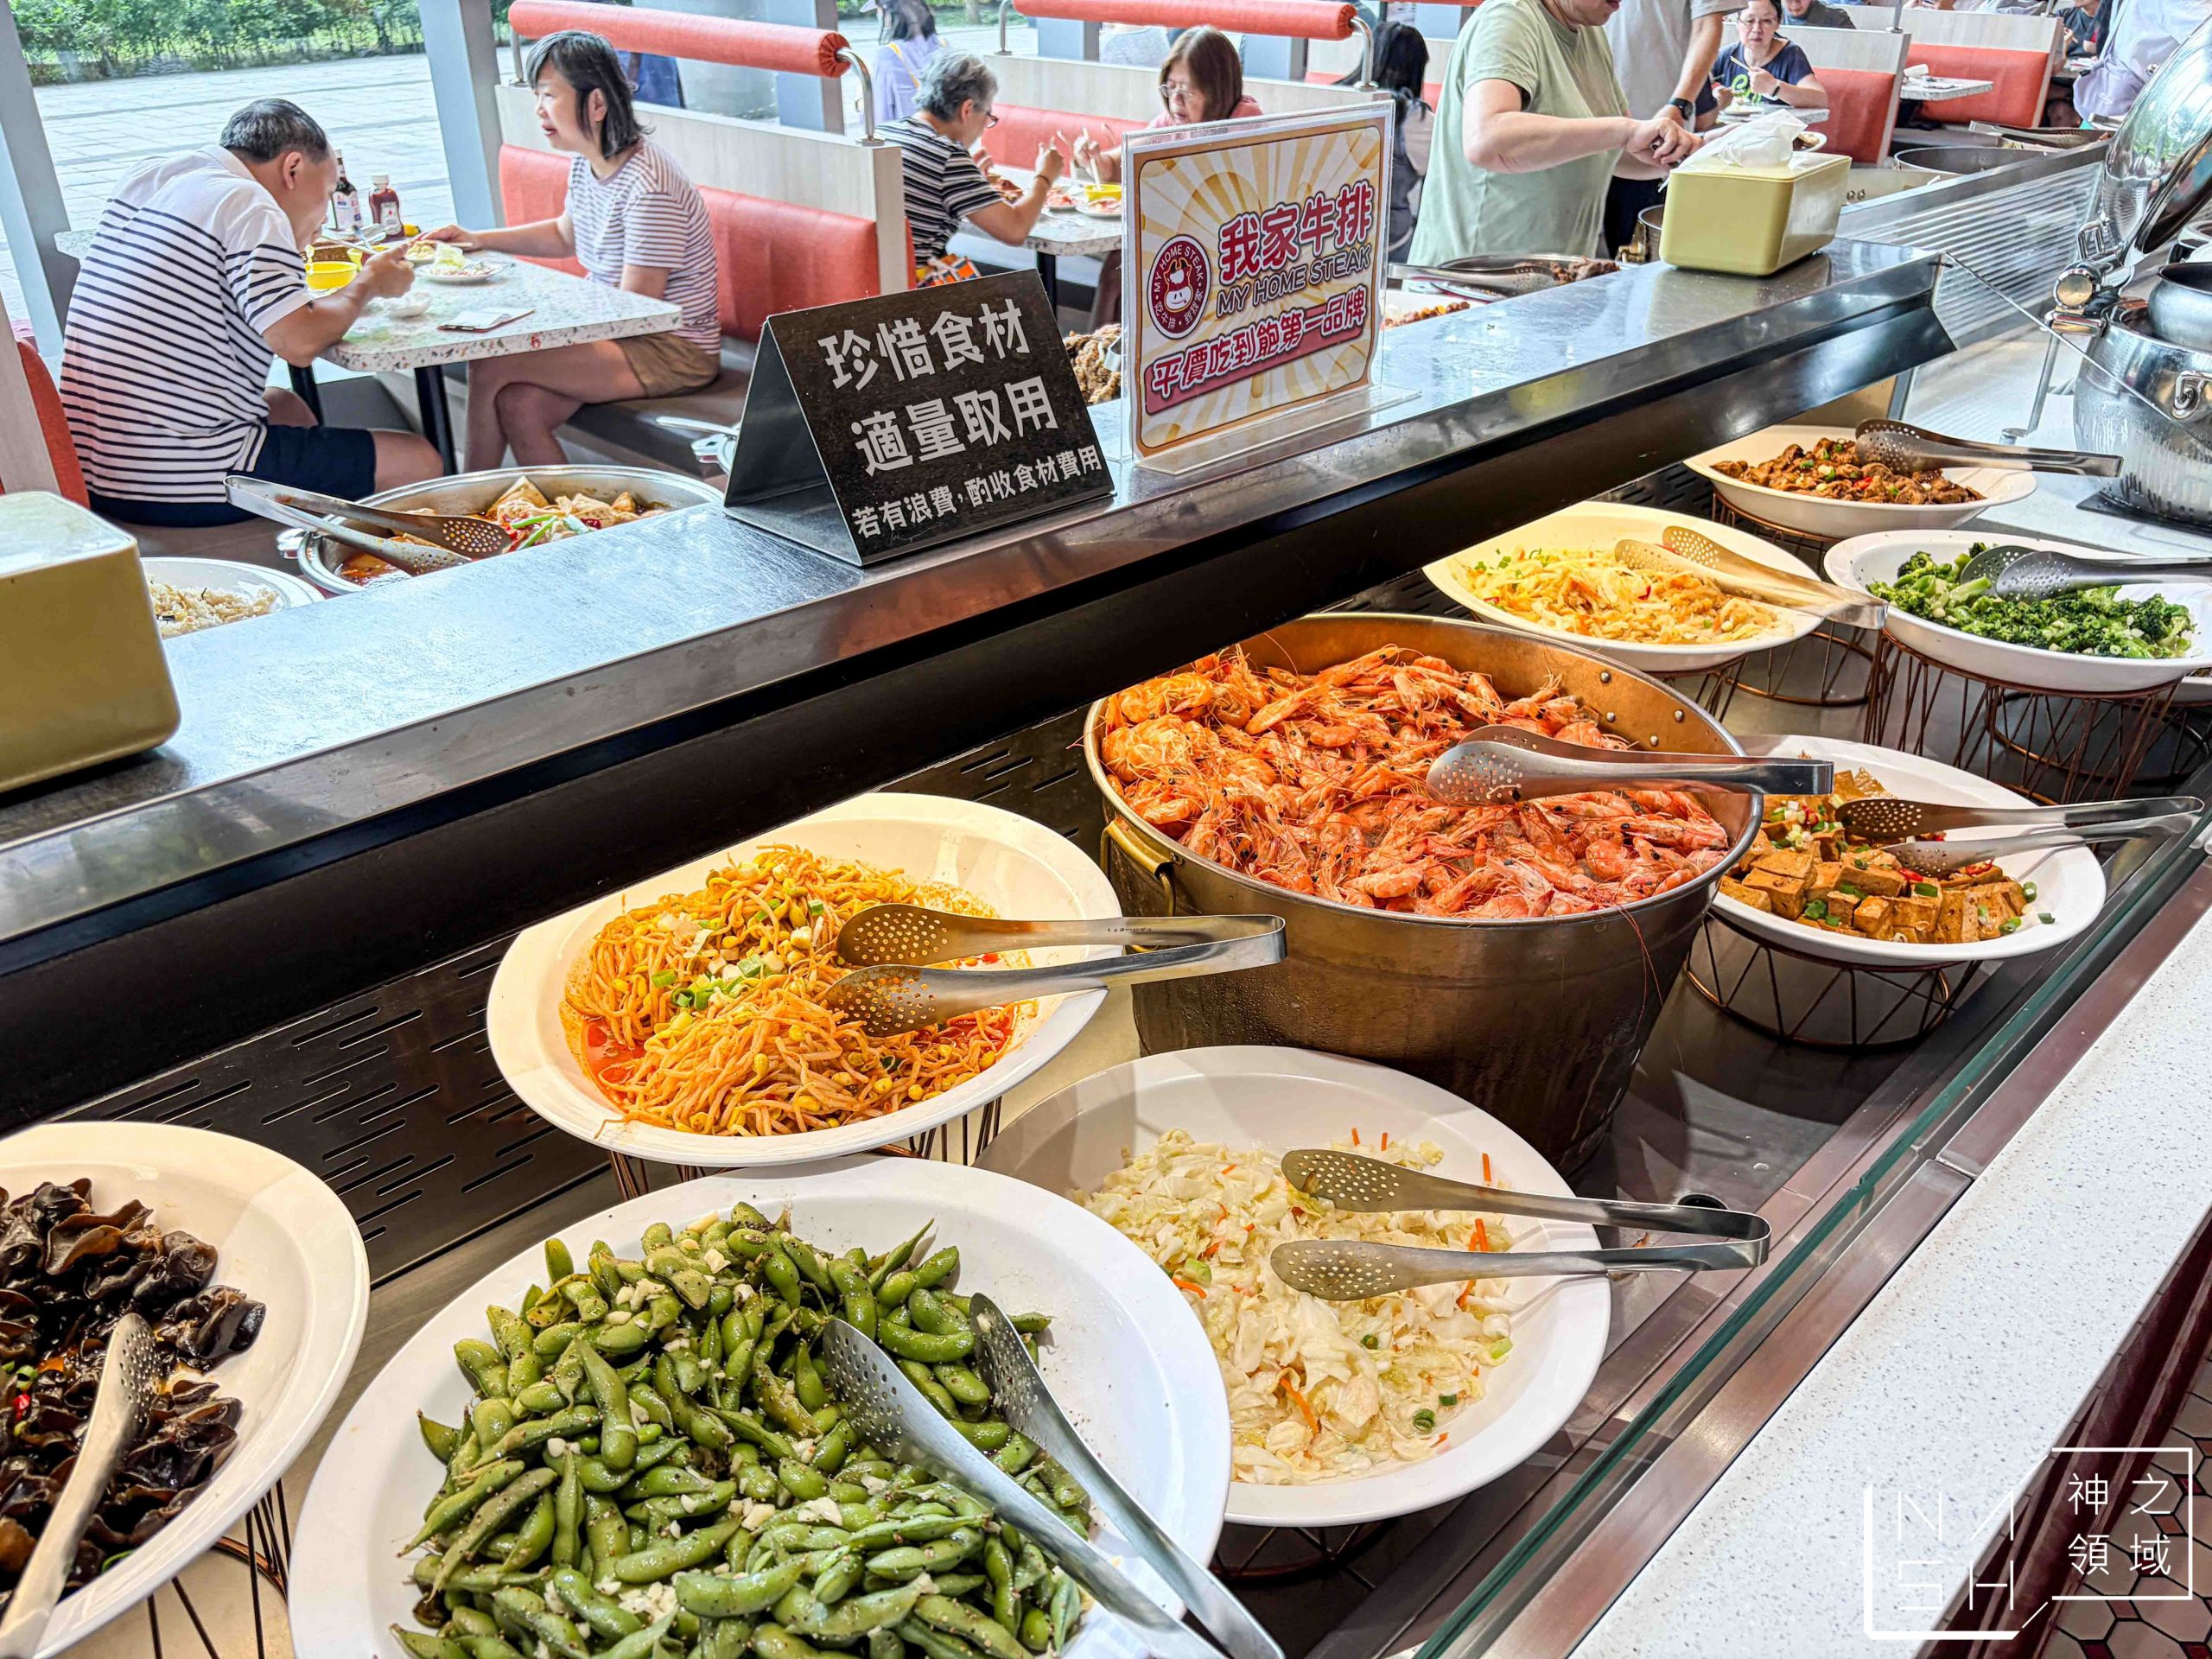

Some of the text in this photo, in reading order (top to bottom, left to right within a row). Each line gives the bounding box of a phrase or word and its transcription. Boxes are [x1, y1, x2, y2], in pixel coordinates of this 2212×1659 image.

[1154, 245, 1204, 292] MY HOME STEAK
[1217, 245, 1371, 316] MY HOME STEAK
[1219, 183, 1373, 283] 我家牛排
[817, 299, 1031, 391] 珍惜食材
[1152, 286, 1367, 399] 平價吃到飽第一品牌
[851, 376, 1058, 477] 適量取用
